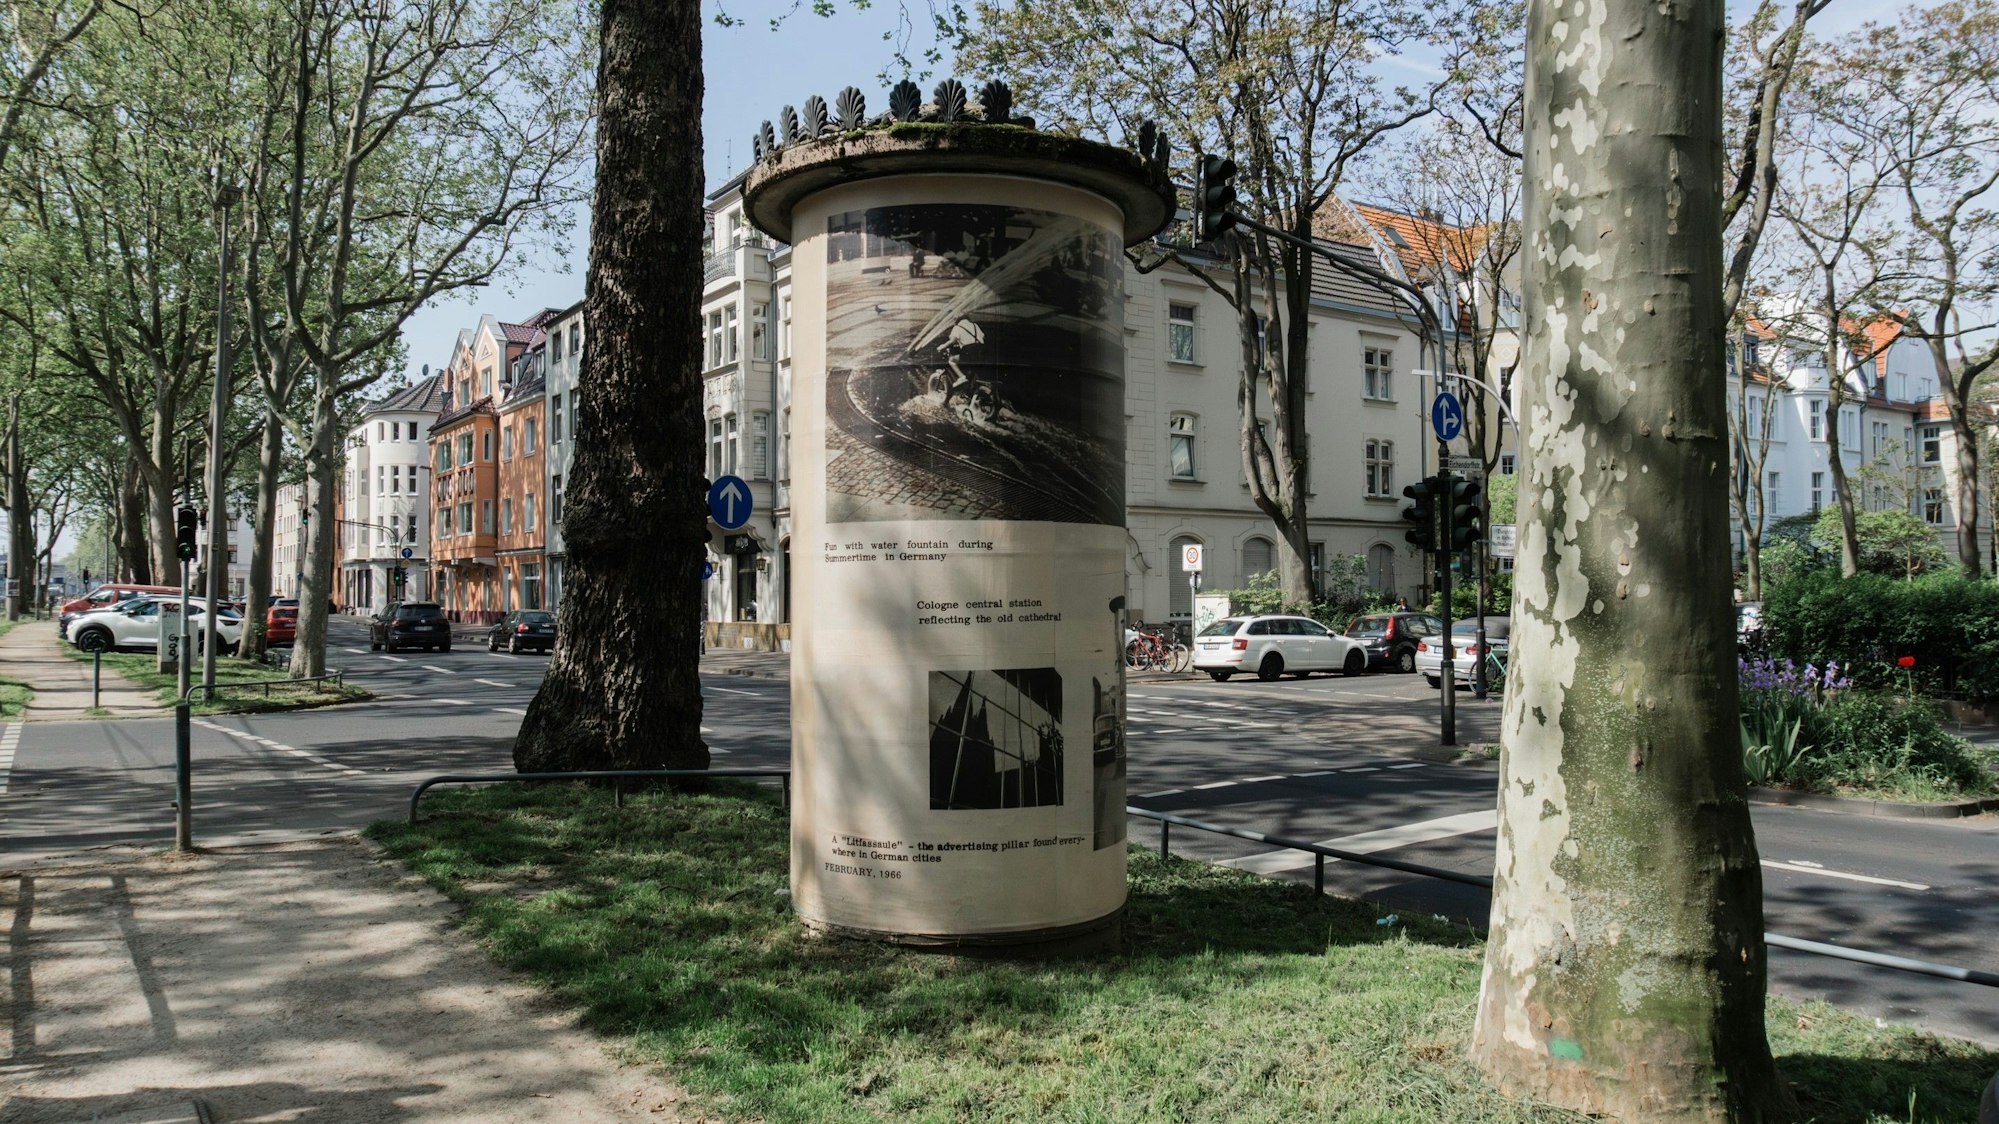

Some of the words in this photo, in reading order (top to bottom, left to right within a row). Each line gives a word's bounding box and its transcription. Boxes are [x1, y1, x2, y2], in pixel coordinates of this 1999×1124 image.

[824, 542, 838, 551] Fun
[845, 541, 864, 550] with
[870, 541, 899, 550] water
[907, 540, 949, 549] fountain
[958, 539, 994, 551] during
[824, 553, 877, 563] Summertime
[885, 553, 895, 561] in
[899, 552, 947, 562] Germany
[917, 600, 959, 612] Cologne
[965, 600, 1003, 609] central
[1009, 598, 1042, 608] station
[918, 615, 971, 626] reflecting
[976, 614, 992, 624] the
[997, 613, 1013, 623] old
[1018, 612, 1062, 622] cathedral
[832, 835, 838, 844] A
[917, 841, 934, 851] the
[937, 841, 998, 853] advertising
[1001, 840, 1030, 852] pillar
[1033, 836, 1057, 848] found
[1059, 836, 1085, 847] every-
[832, 847, 856, 858] where
[858, 850, 868, 859] in
[870, 850, 909, 862] German
[912, 853, 942, 863] cities
[825, 862, 876, 879] FEBRUARY,
[879, 870, 902, 880] 1966
